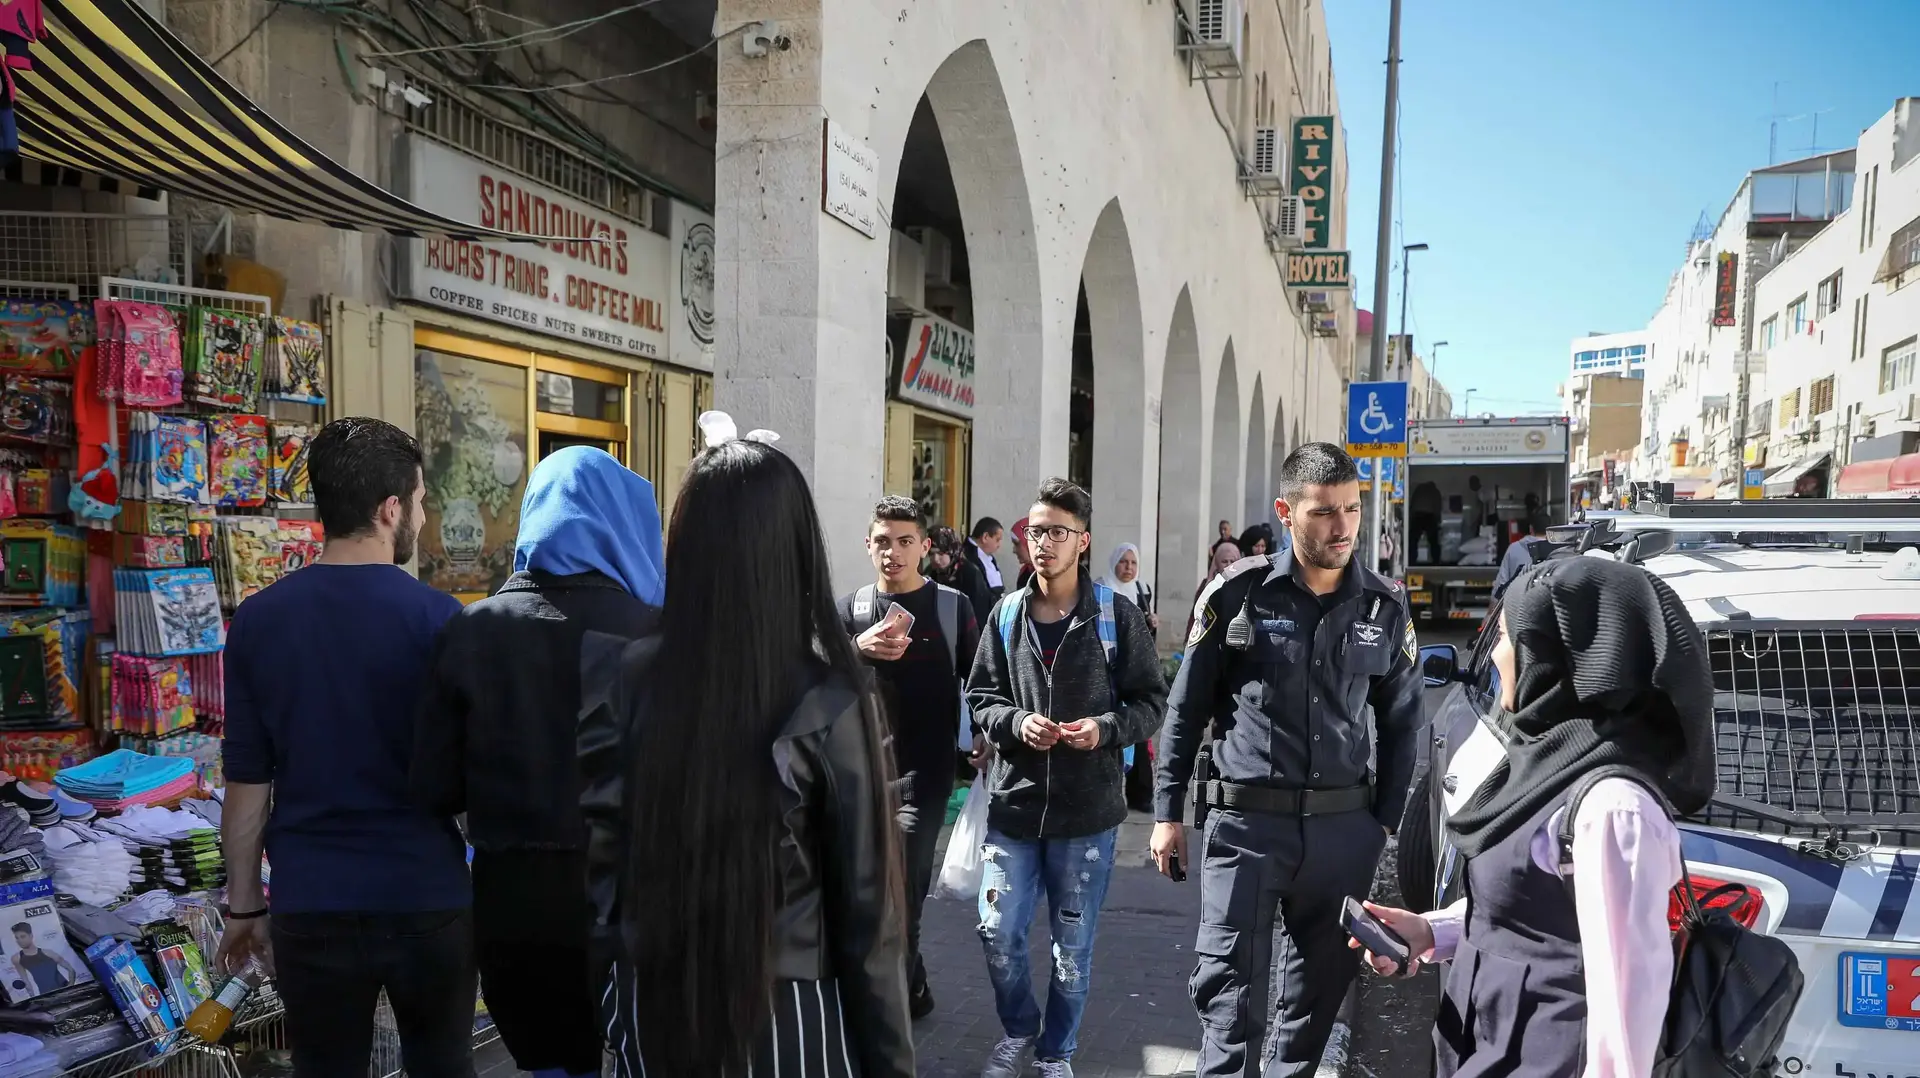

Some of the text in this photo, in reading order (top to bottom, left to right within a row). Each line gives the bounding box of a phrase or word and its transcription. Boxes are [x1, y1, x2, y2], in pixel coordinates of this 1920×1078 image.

[1298, 125, 1328, 242] RIVOLI
[1288, 255, 1348, 283] HOTEL
[566, 274, 629, 323] COFFEE
[632, 295, 664, 333] MILL
[429, 286, 656, 354] COFFEE SPICES NUTS SWEETS GIFTS
[26, 905, 51, 917] N.T.A
[1861, 974, 1878, 997] IL
[1856, 997, 1883, 1005] ישראל
